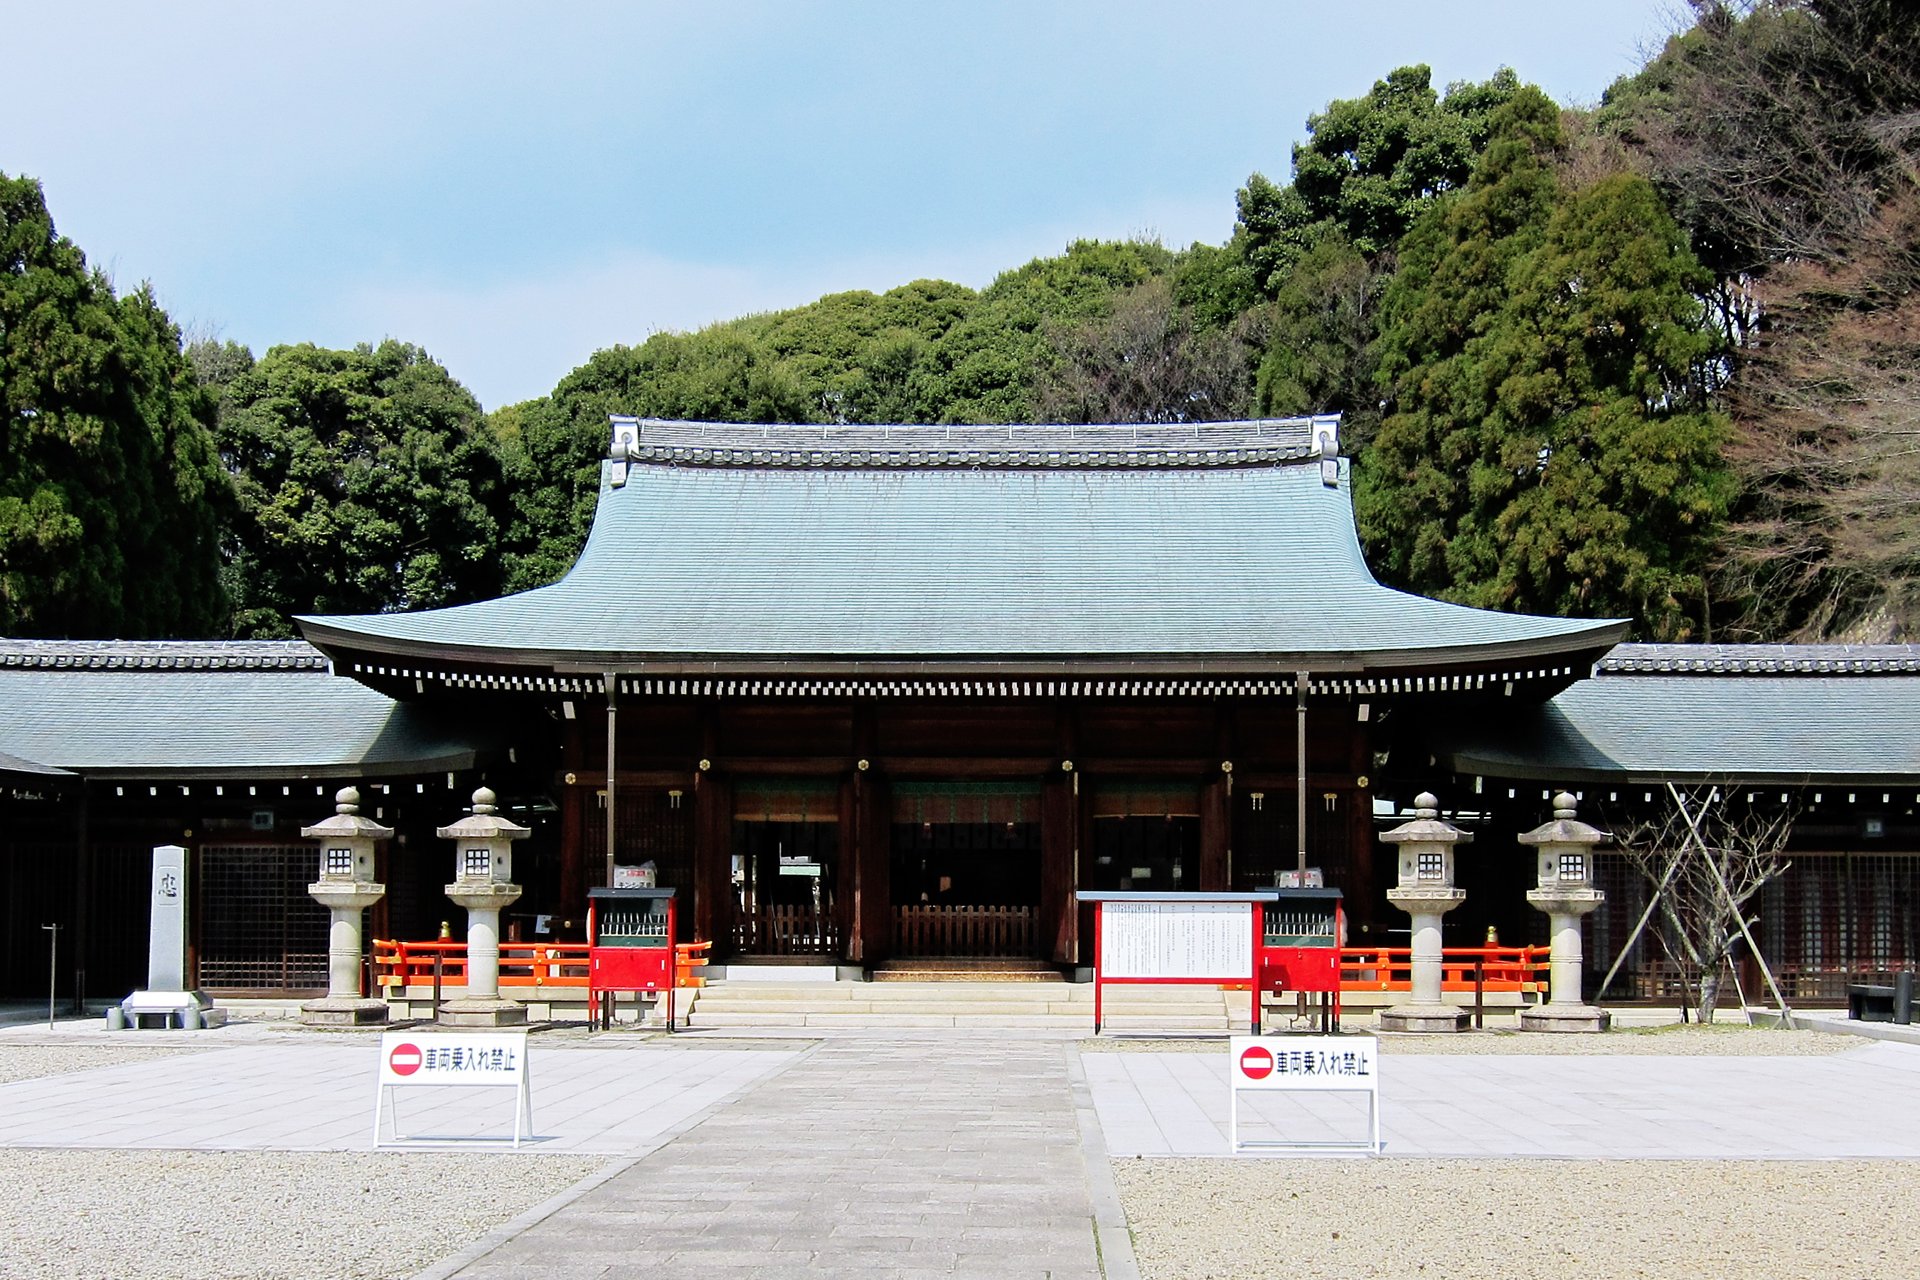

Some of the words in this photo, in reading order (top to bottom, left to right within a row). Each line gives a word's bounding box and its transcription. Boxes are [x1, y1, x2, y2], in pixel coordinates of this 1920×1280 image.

[425, 1047, 515, 1072] 車両乗入れ禁止
[1277, 1051, 1369, 1076] 車両乗入れ禁止
